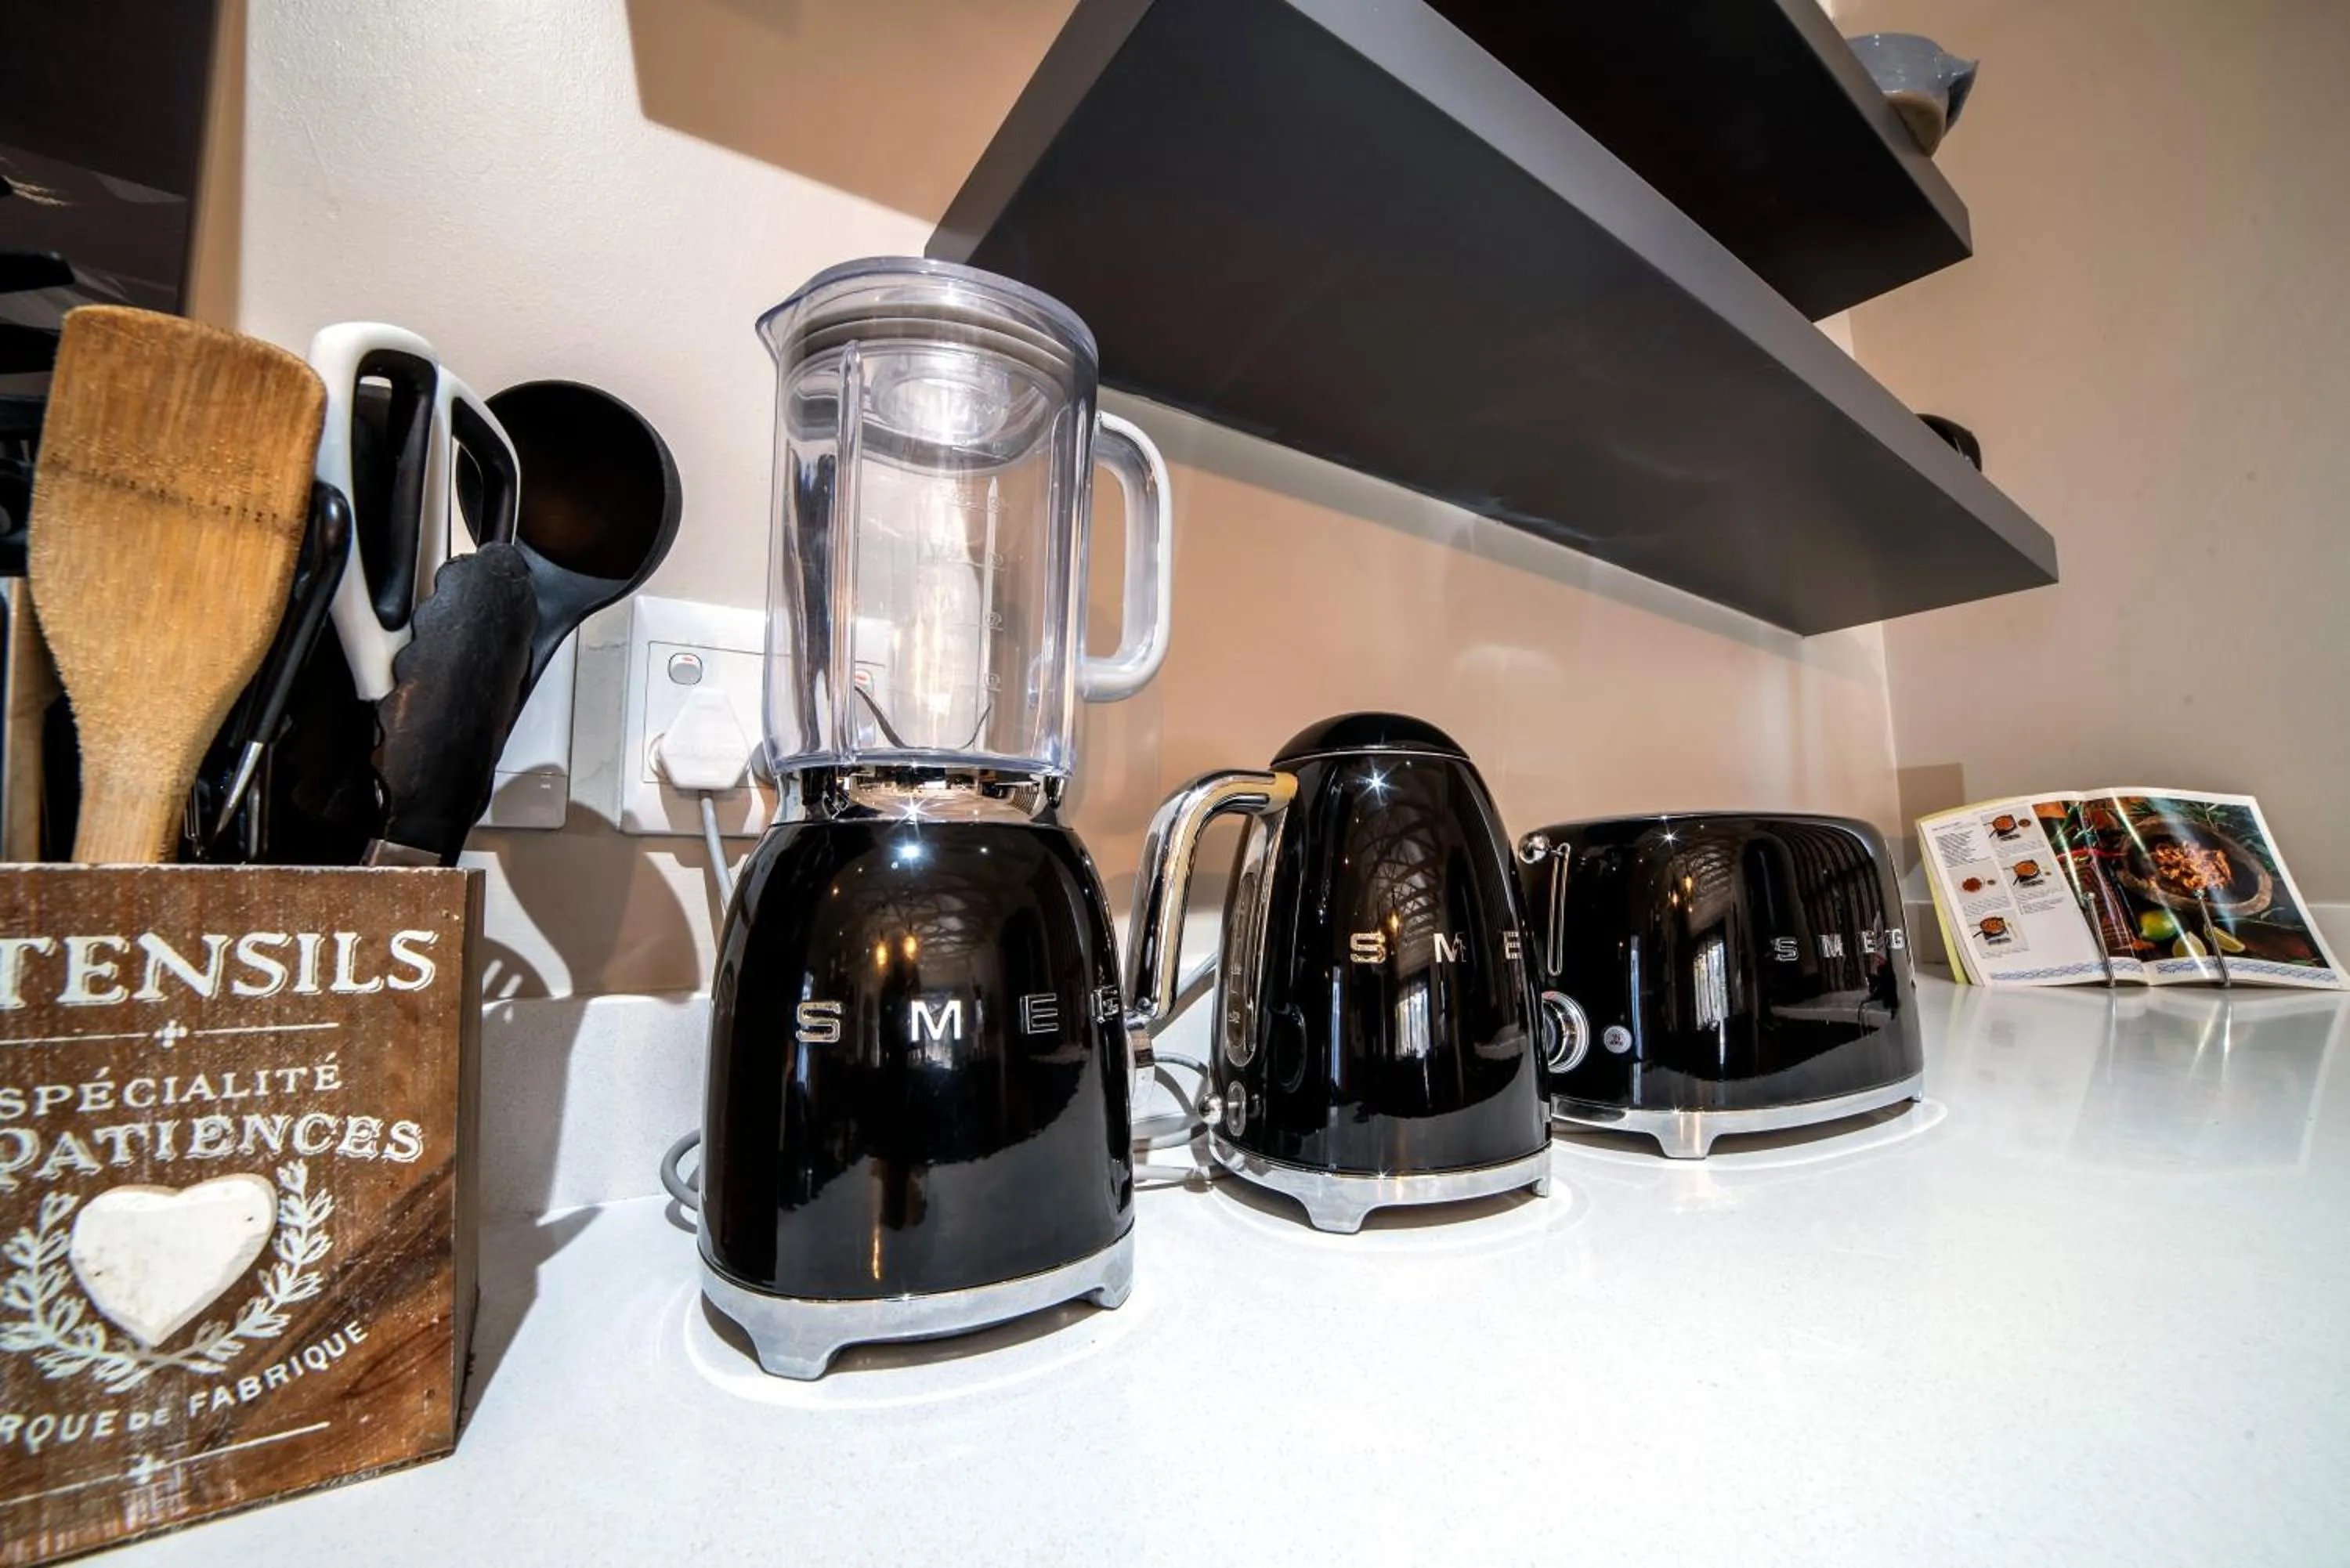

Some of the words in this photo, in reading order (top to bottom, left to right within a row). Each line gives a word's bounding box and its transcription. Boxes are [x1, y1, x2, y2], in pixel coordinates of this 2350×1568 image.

[1774, 927, 1905, 962] SMEG
[0, 1051, 343, 1120] SPÉCIALITÉ
[188, 1319, 369, 1419] FABRIQUE
